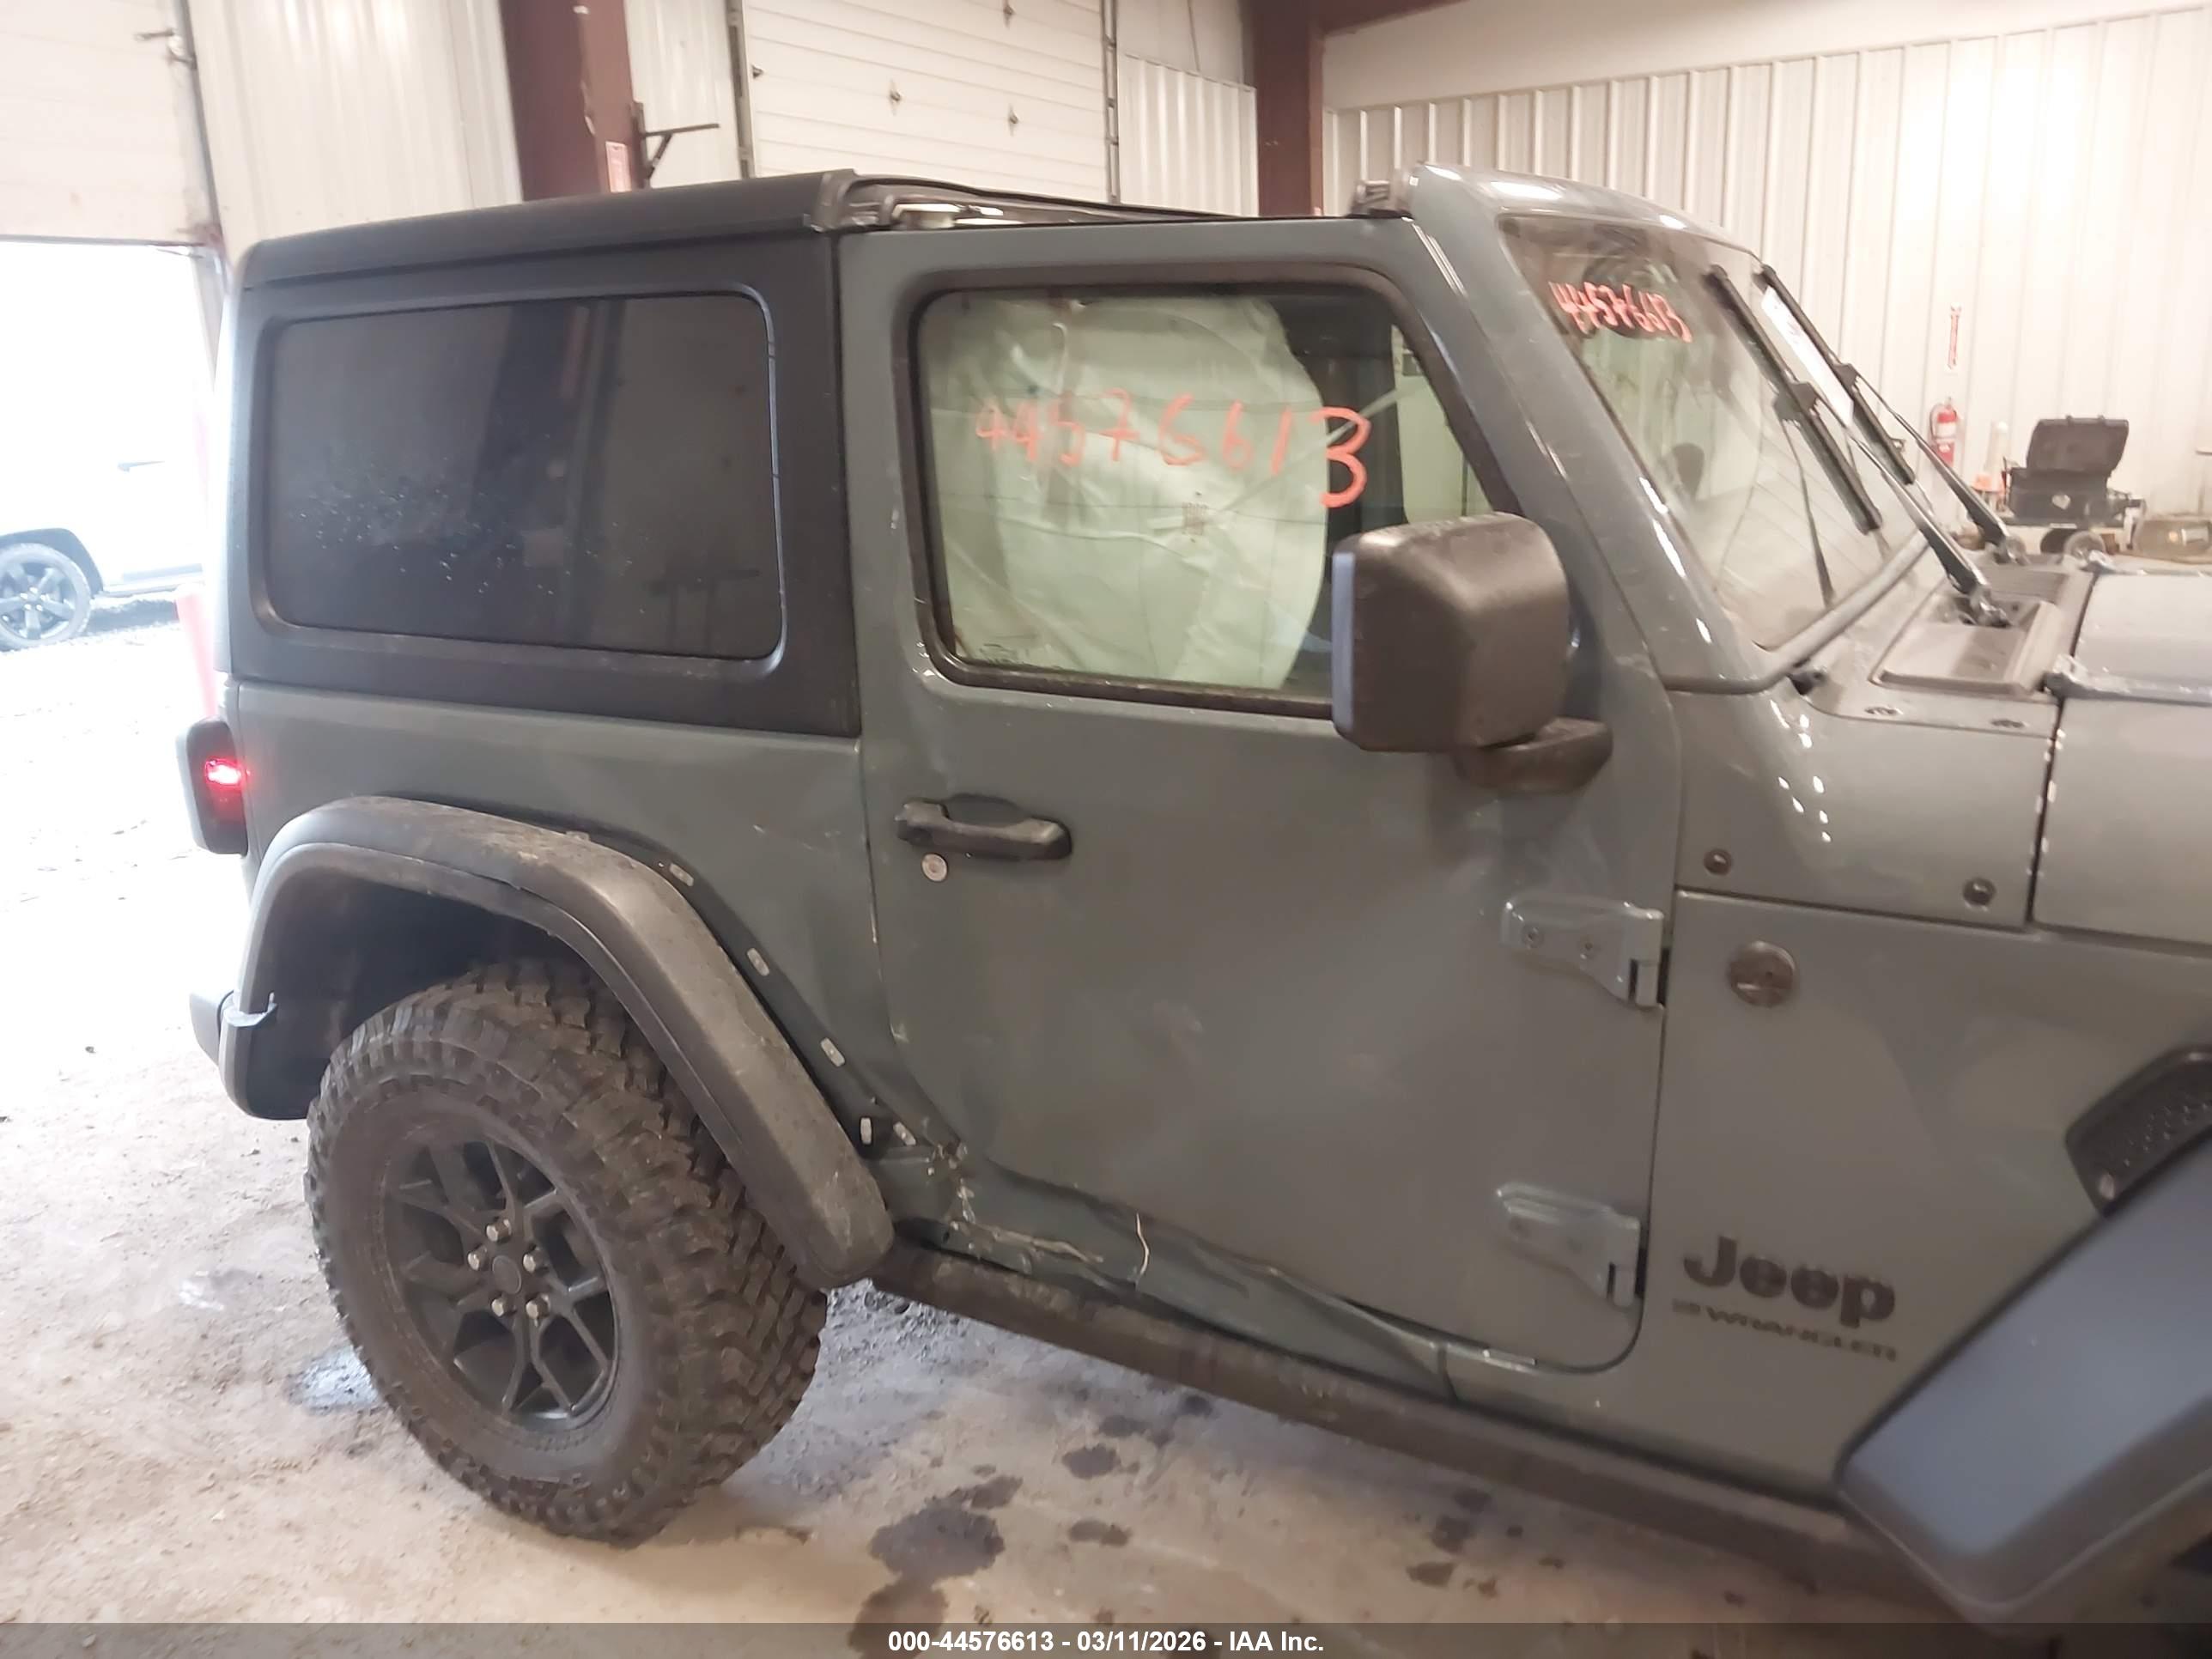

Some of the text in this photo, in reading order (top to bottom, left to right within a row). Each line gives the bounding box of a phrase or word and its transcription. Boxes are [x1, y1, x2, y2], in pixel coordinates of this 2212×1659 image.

[1548, 281, 1693, 343] 44576613
[975, 387, 1370, 508] 44576613
[1683, 1235, 1896, 1328] Jeep
